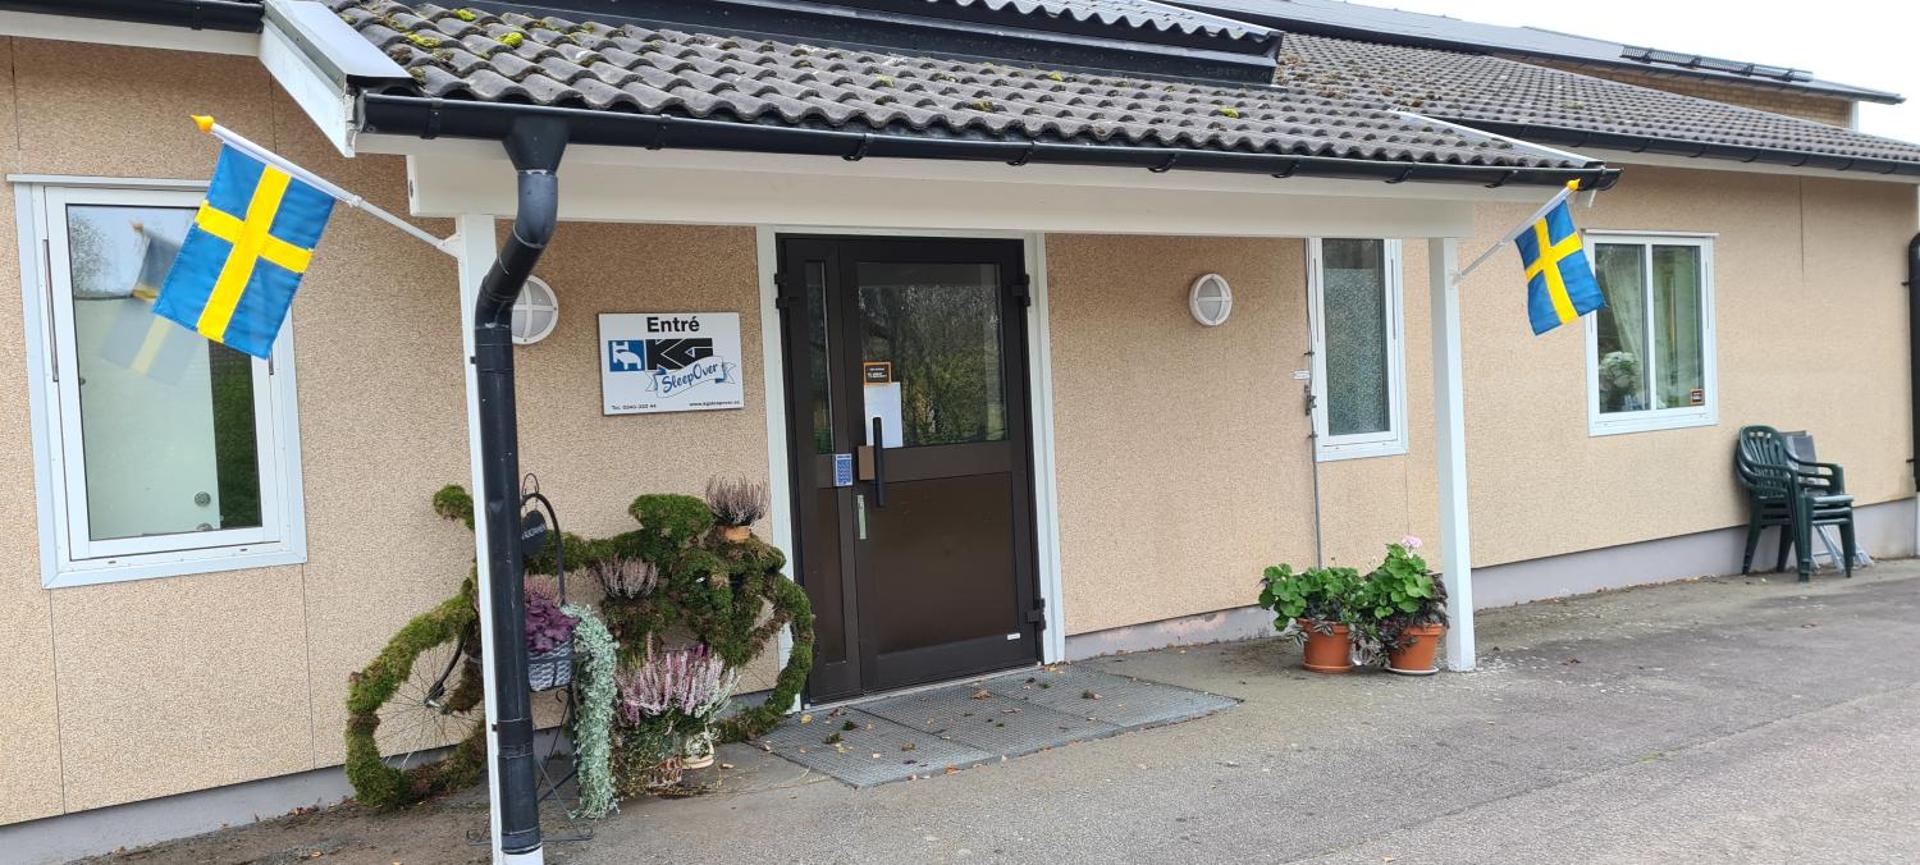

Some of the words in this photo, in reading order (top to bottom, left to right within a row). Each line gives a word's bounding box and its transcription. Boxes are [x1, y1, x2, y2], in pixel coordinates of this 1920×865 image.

[646, 316, 700, 333] Entré
[645, 337, 714, 371] KG
[661, 362, 718, 394] SleepOver
